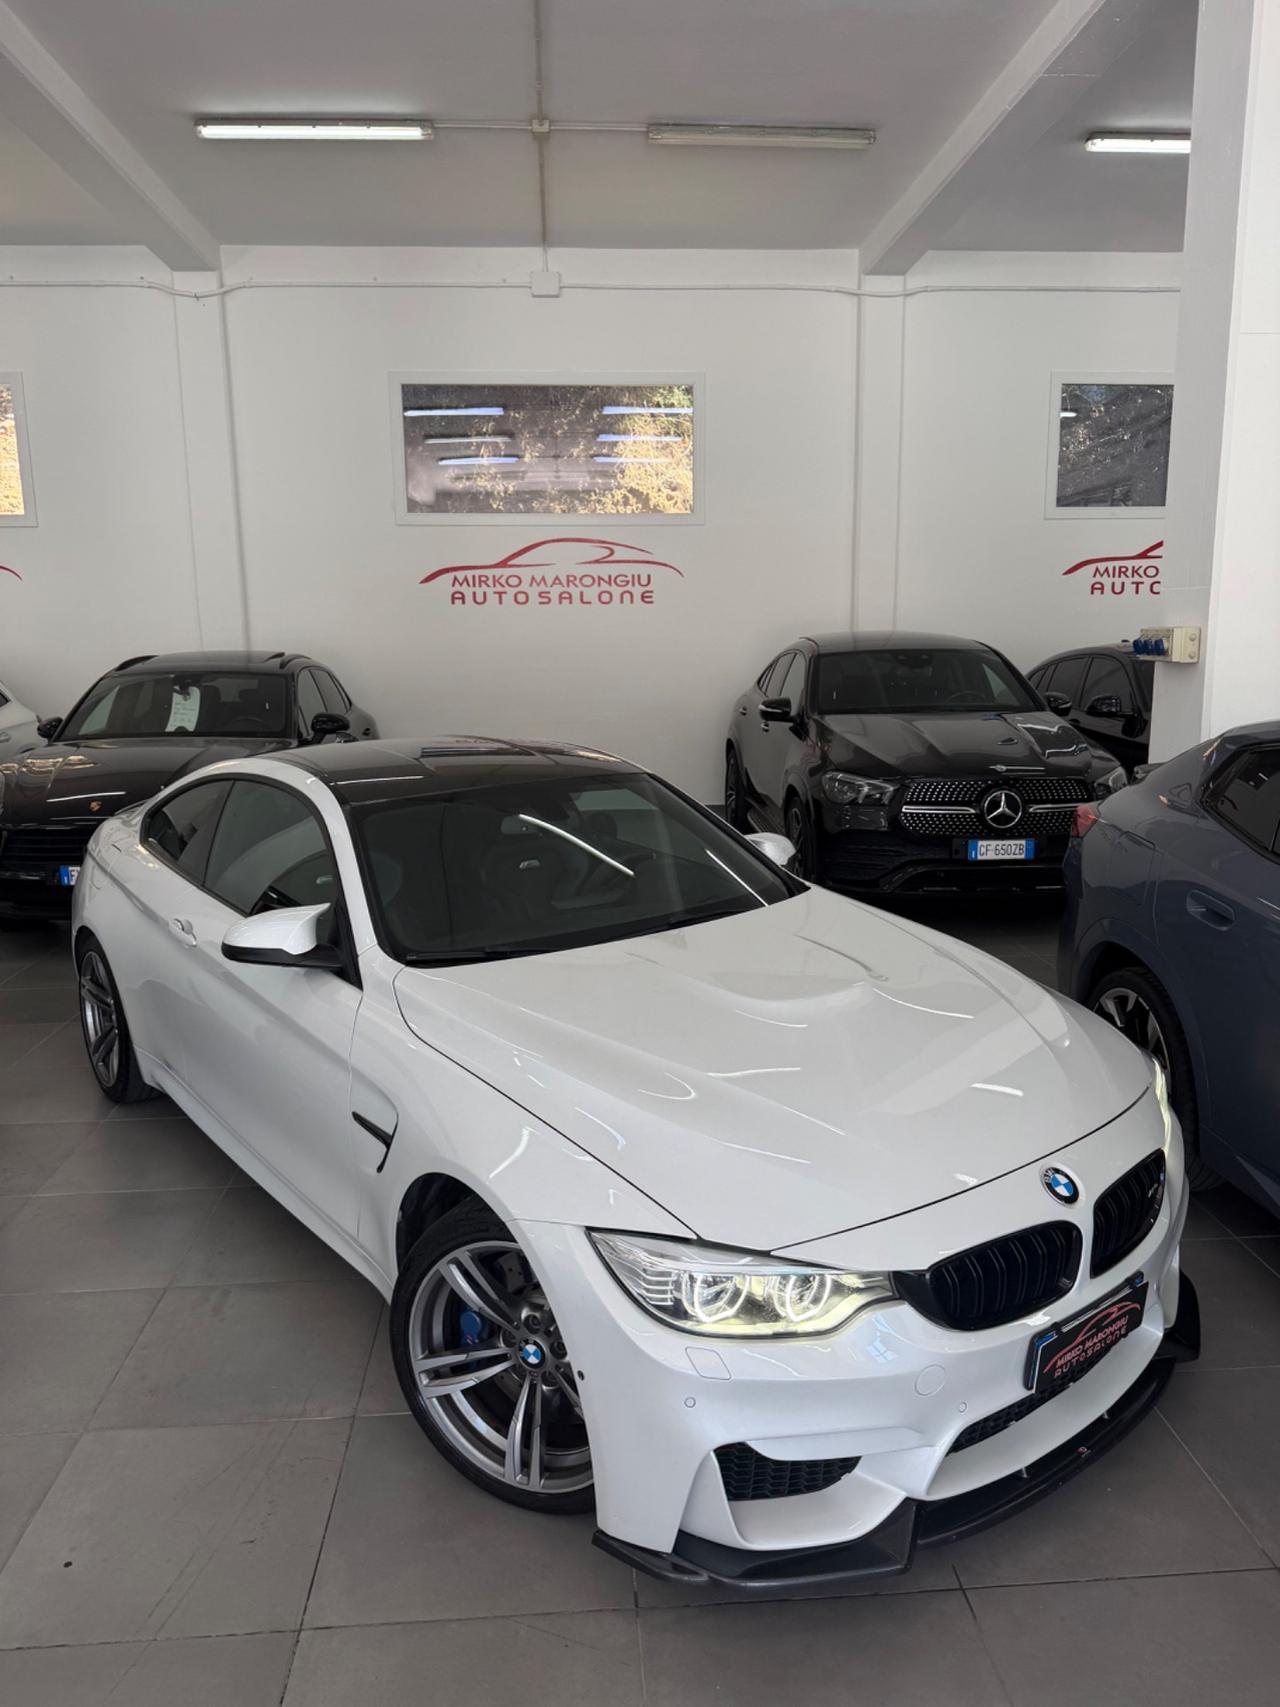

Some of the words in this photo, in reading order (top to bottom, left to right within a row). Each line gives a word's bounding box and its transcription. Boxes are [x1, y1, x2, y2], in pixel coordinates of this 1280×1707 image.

[1092, 565, 1160, 578] MIRKO
[452, 574, 522, 588] MIRKO
[529, 574, 651, 588] MARONGIU
[451, 590, 654, 605] AUTOSALONE
